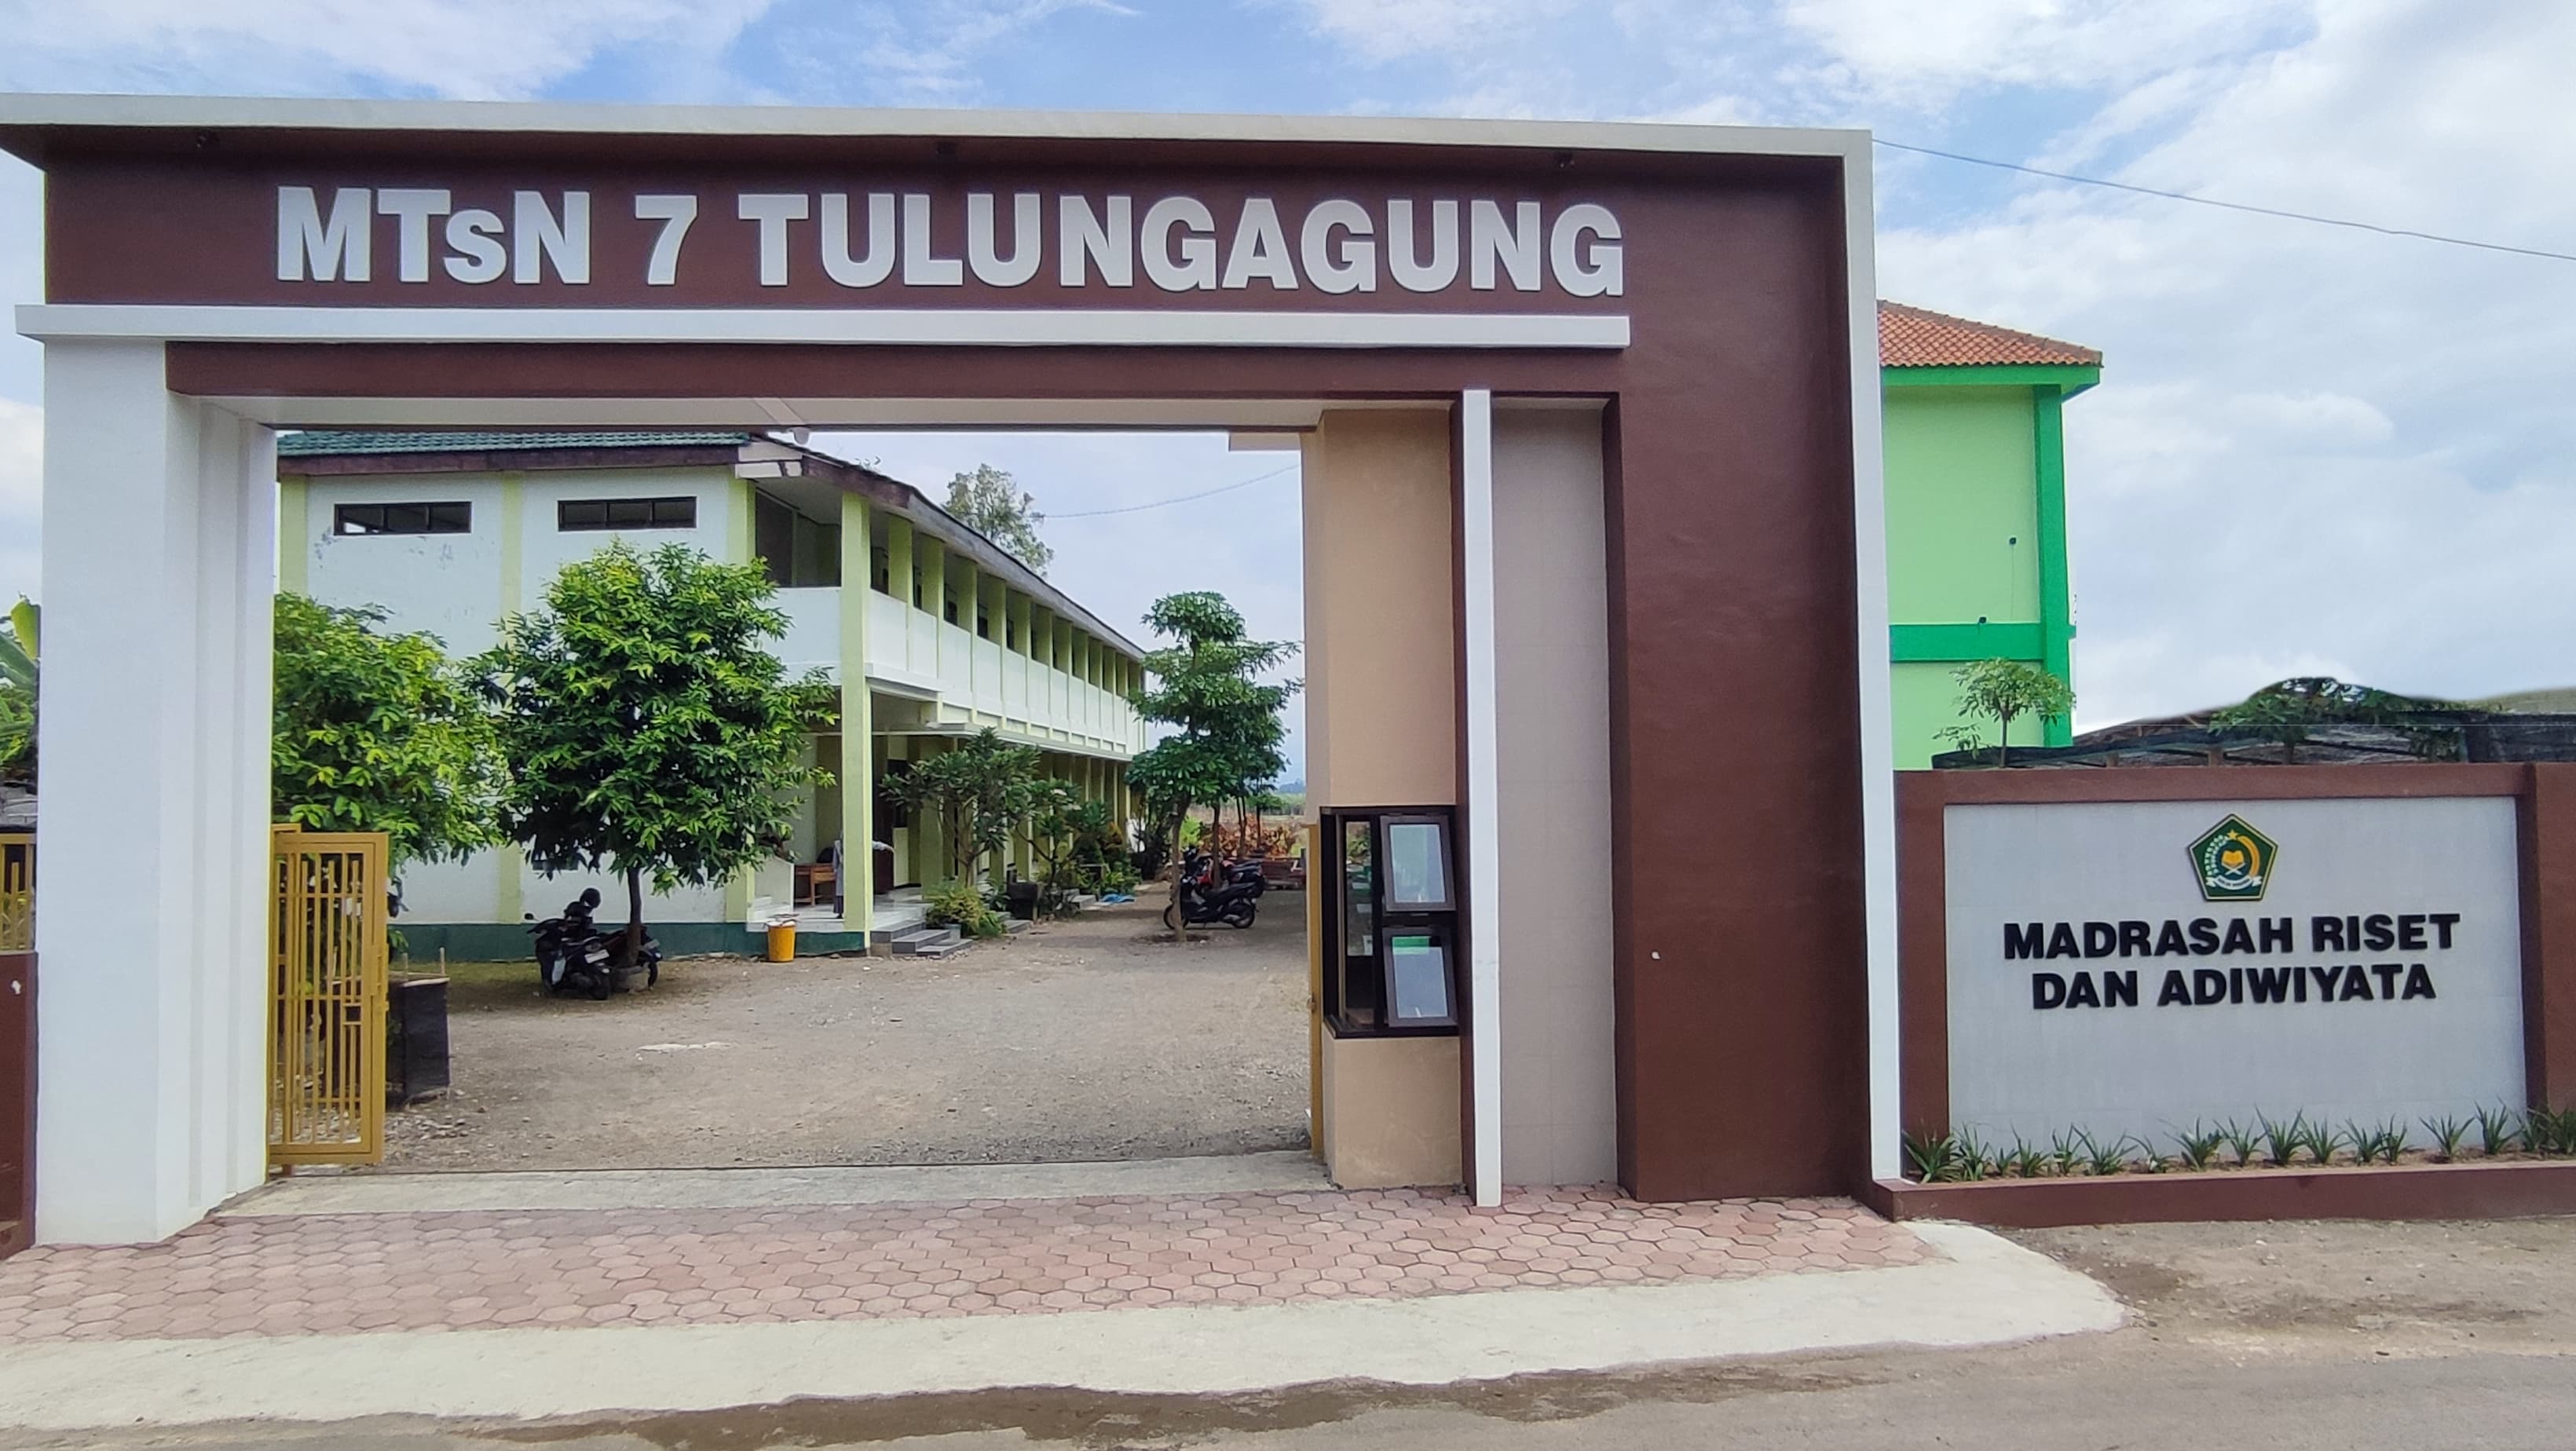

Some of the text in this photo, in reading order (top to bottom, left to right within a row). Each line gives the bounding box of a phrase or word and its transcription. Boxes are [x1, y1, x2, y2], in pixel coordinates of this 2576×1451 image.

[277, 186, 1625, 298] MTsN 7 TULUNGAGUNG
[2003, 913, 2461, 960] MADRASAH RISET
[2031, 963, 2438, 1010] DAN ADIWIYATA
